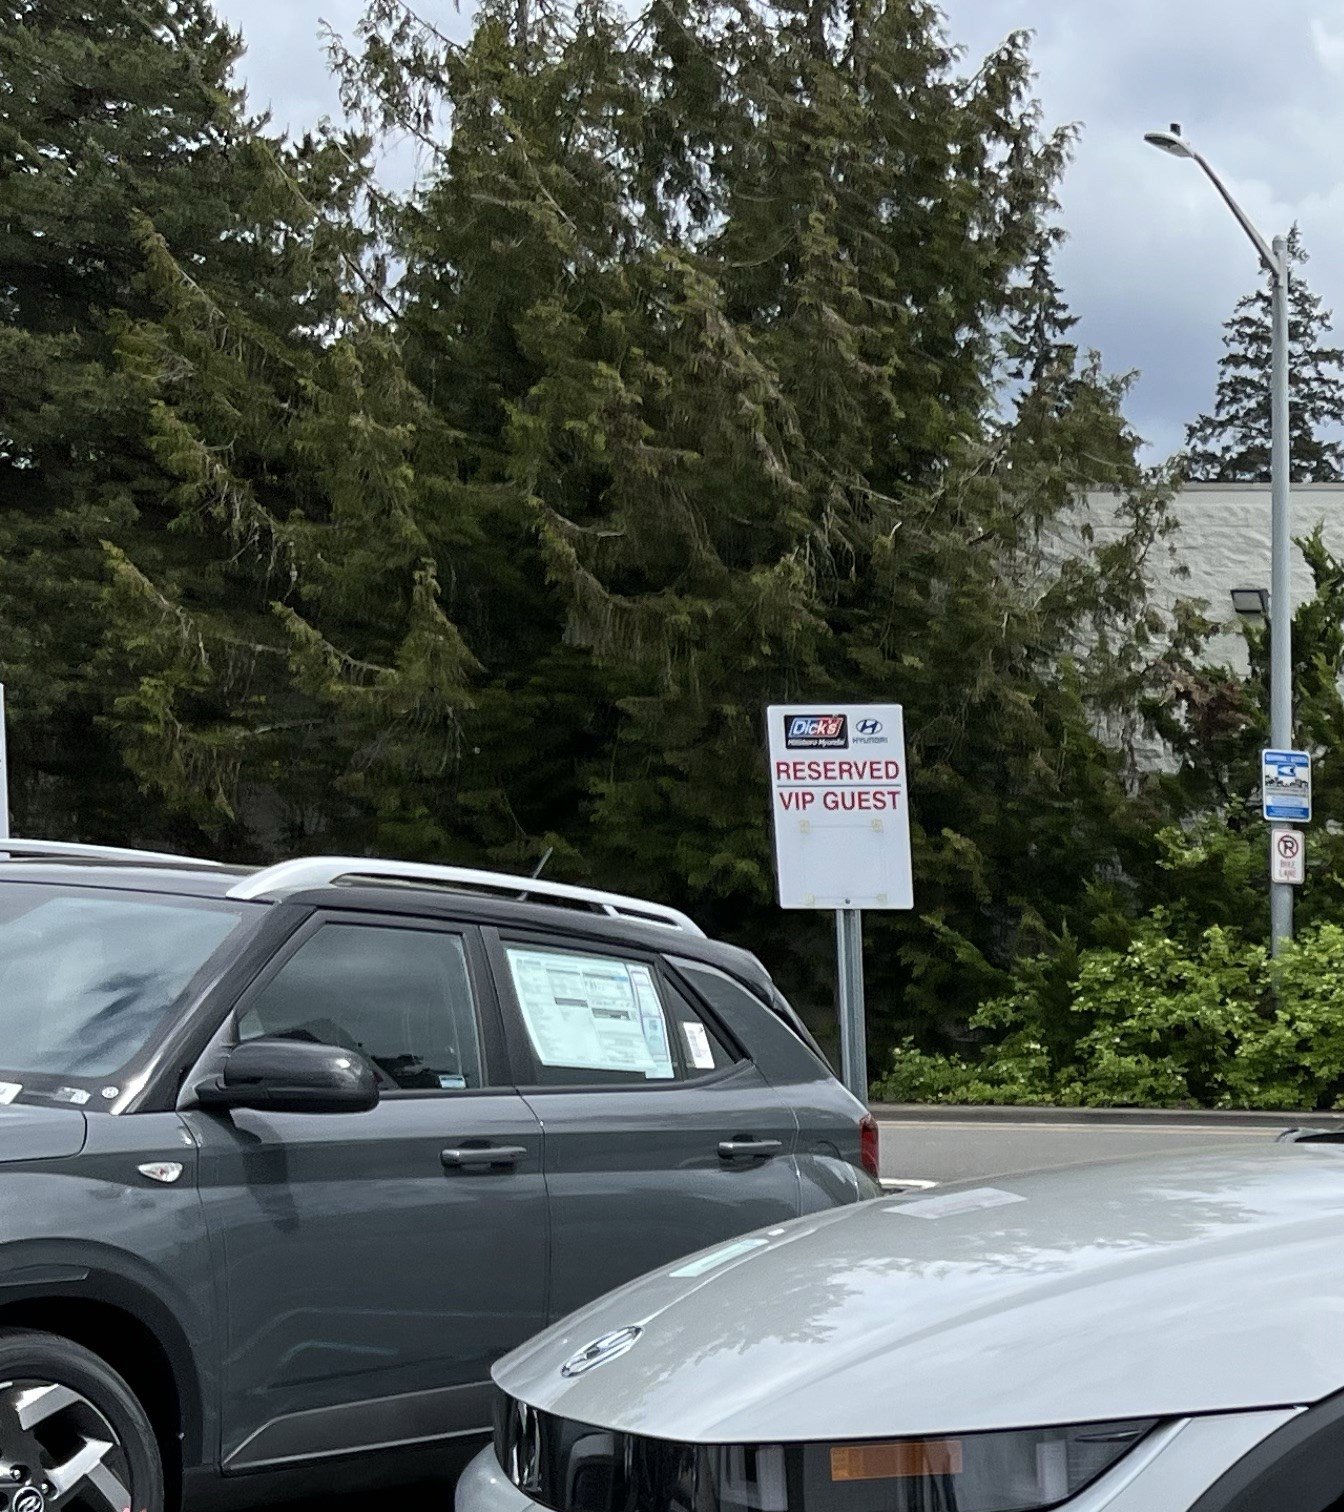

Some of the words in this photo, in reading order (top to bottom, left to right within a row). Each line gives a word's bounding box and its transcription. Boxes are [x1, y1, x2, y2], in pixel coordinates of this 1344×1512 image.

[776, 760, 900, 781] RESERVED
[779, 791, 815, 811] VIP
[823, 790, 901, 811] GUEST
